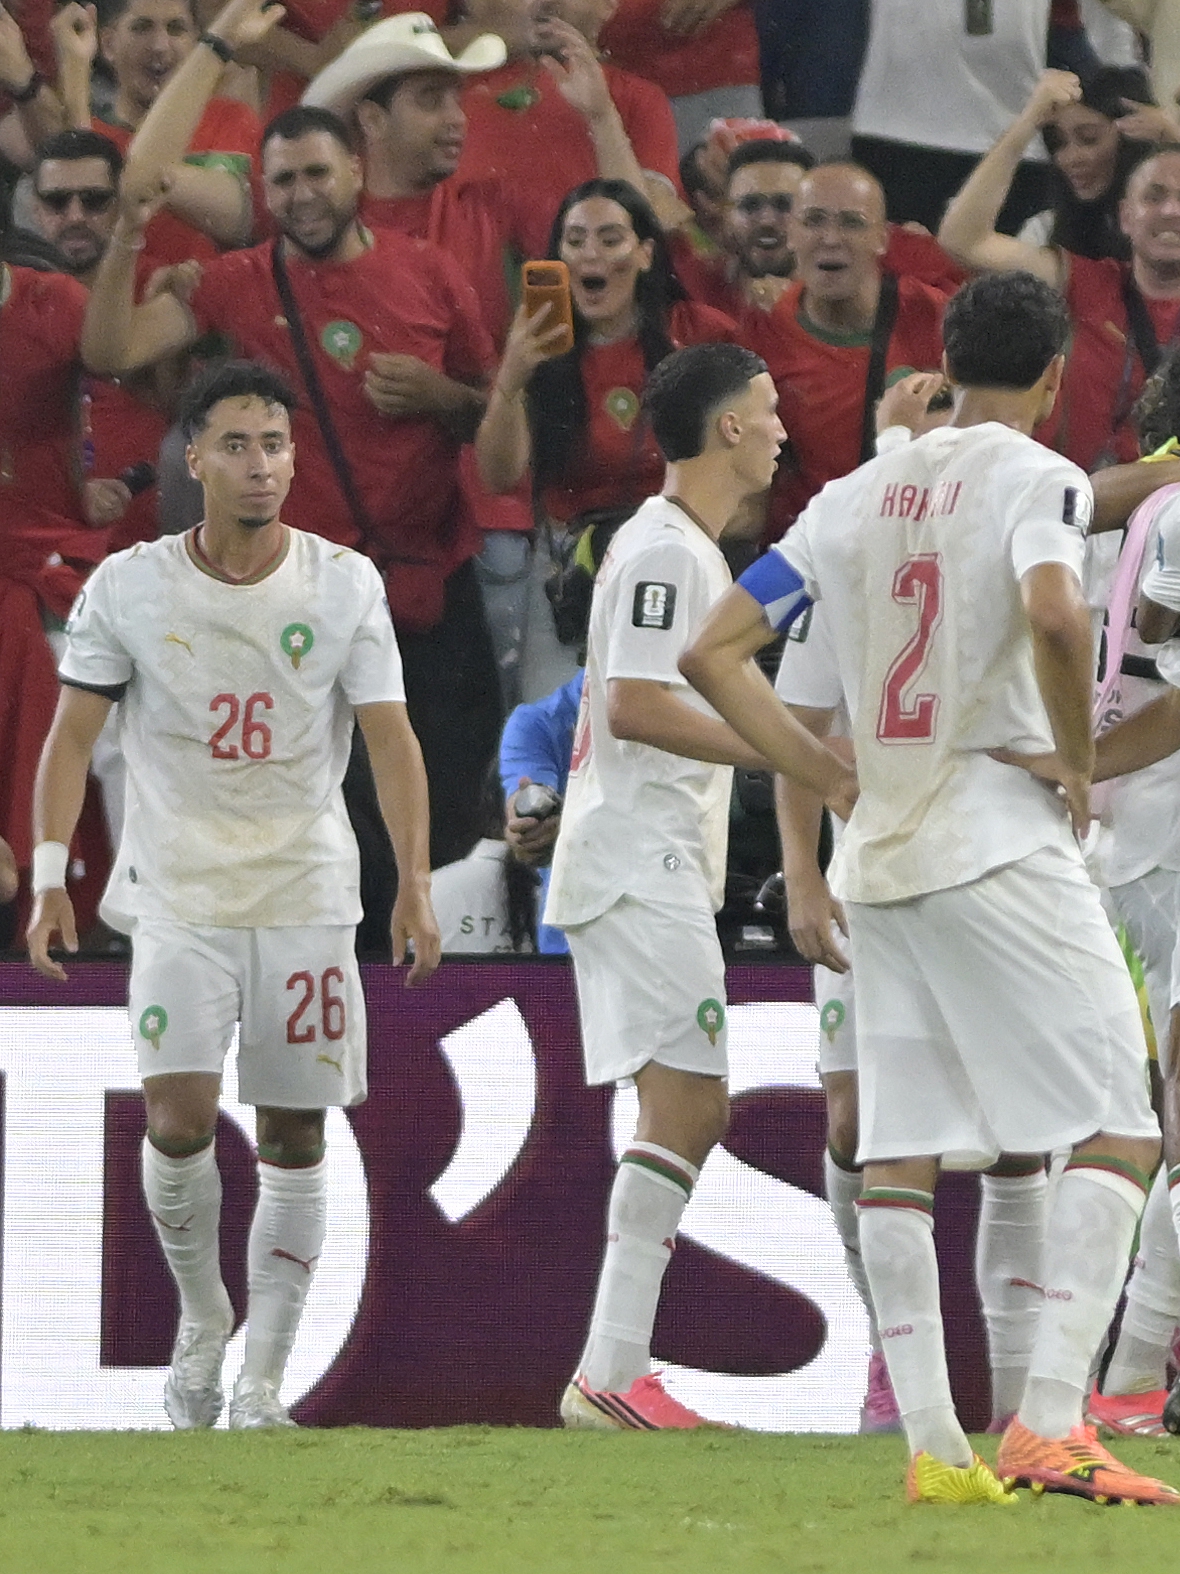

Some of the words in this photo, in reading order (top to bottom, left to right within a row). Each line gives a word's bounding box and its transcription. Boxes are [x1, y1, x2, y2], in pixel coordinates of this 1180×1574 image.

[876, 551, 945, 746] 2
[209, 691, 274, 760] 26
[286, 966, 346, 1044] 26
